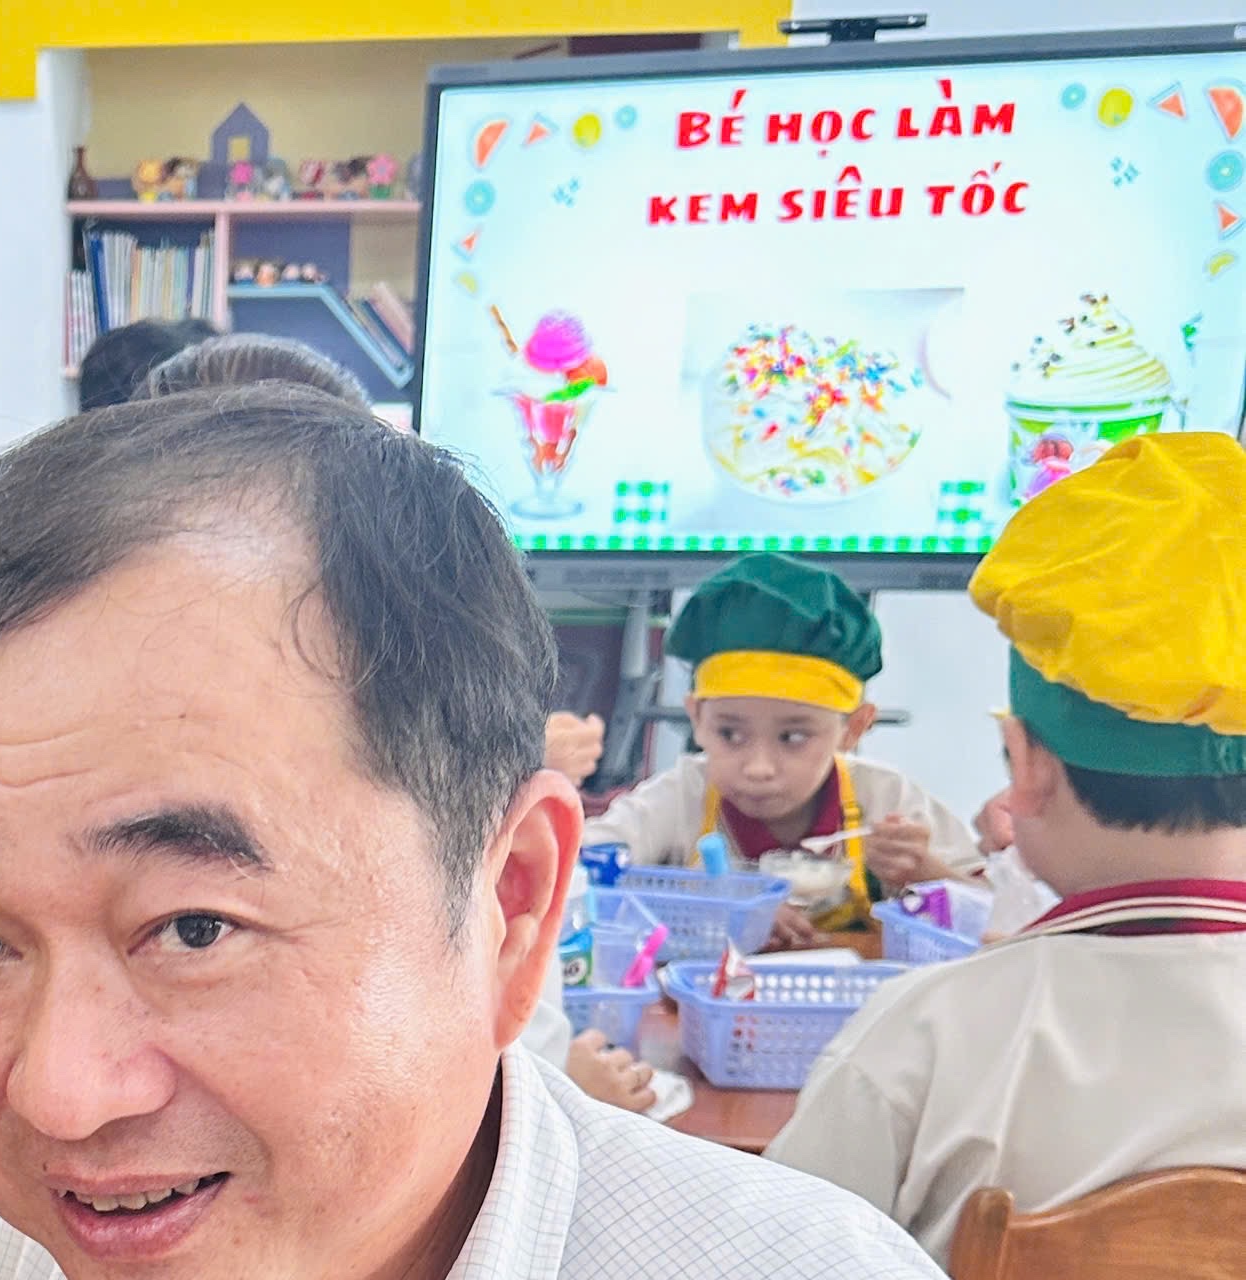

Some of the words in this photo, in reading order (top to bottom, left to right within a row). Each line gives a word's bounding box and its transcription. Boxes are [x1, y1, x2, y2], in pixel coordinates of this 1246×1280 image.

[677, 88, 747, 149] BÉ
[766, 107, 876, 157] HỌC
[896, 78, 1017, 140] LÀM
[648, 192, 759, 225] KEM
[778, 164, 904, 222] SIÊU
[926, 162, 1030, 216] TỐC
